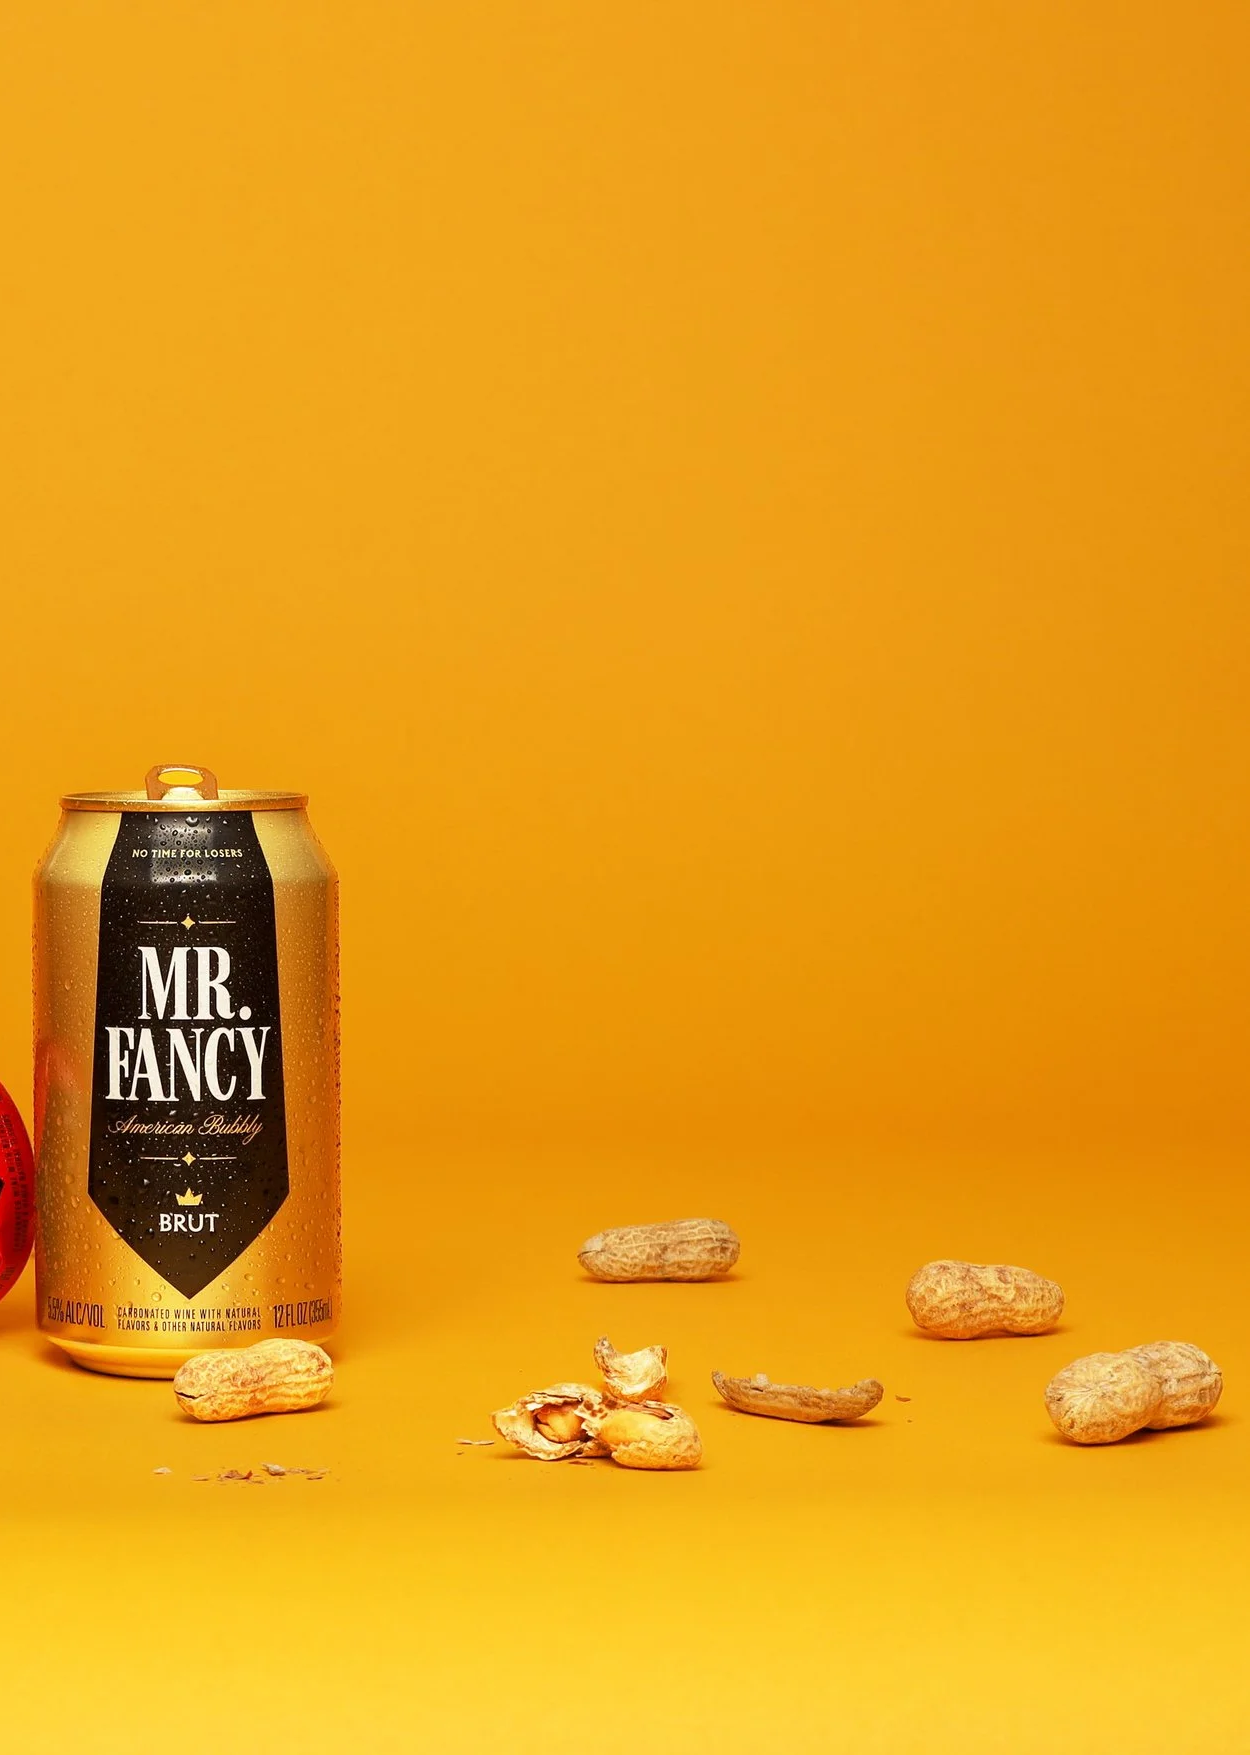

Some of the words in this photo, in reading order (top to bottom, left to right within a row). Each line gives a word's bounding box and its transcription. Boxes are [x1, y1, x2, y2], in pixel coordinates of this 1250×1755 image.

[132, 849, 148, 858] NO
[152, 849, 177, 858] TIME
[180, 849, 202, 858] FOR
[204, 849, 243, 858] LOSERS
[138, 946, 252, 1020] MR.
[105, 1026, 271, 1101] FANCY
[108, 1114, 195, 1135] American
[198, 1113, 264, 1146] Bubbly
[159, 1213, 219, 1232] BRUT
[66, 1300, 105, 1328] ALC/VOL
[117, 1306, 170, 1319] CARBONATED
[174, 1309, 196, 1319] WINE
[200, 1308, 221, 1319] WITH
[225, 1306, 261, 1319] NATURAL
[117, 1319, 150, 1331] FLAVORS
[153, 1321, 159, 1331] &
[162, 1321, 187, 1332] OTHER
[190, 1320, 226, 1332] NATURAL
[229, 1318, 262, 1331] FLAVORS
[273, 1304, 284, 1328] 12
[286, 1302, 295, 1327] FL
[297, 1301, 308, 1325] OZ
